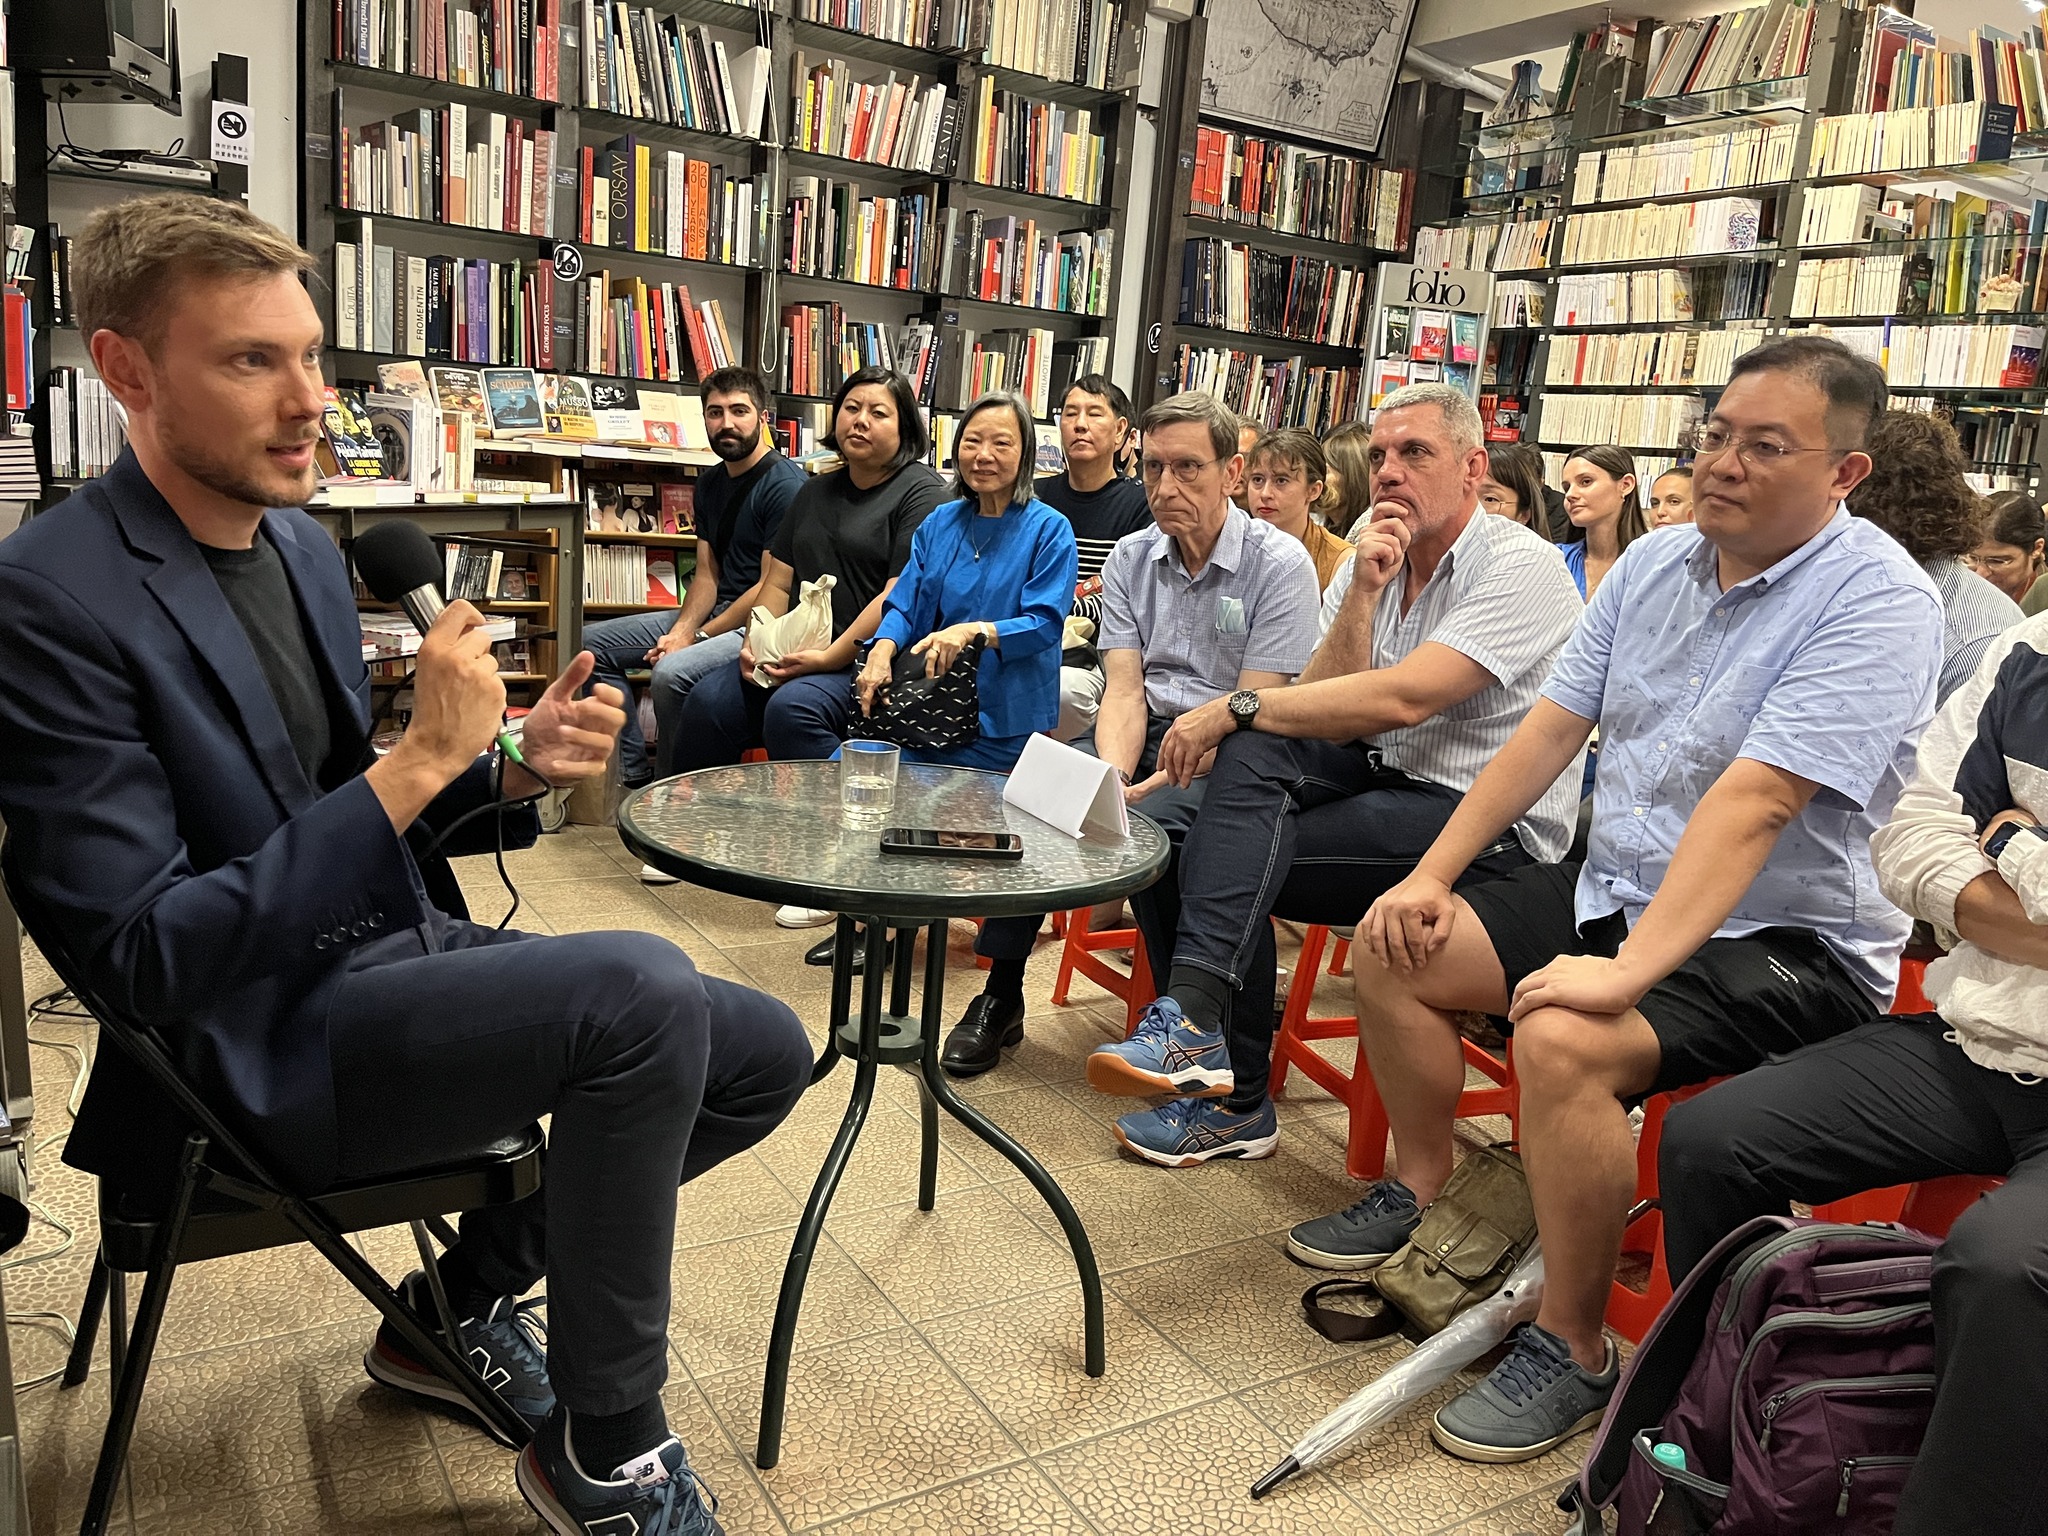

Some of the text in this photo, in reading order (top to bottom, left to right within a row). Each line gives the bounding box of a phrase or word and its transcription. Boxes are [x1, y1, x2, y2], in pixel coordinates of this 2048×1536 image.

[360, 26, 369, 51] Dürer
[634, 27, 647, 82] QUEENS OF EGYPT
[422, 142, 430, 174] Spitzer
[690, 163, 698, 184] 20
[611, 154, 628, 220] ORSAY
[699, 165, 708, 189] 20
[689, 199, 697, 243] YEARS
[698, 208, 706, 239] ANS
[345, 285, 355, 321] FOUJITA
[397, 286, 404, 297] DE
[1405, 268, 1466, 307] folio
[416, 286, 424, 341] FROMENTIN
[1039, 354, 1050, 397] WILMOTTE
[559, 397, 588, 408] MUSSO
